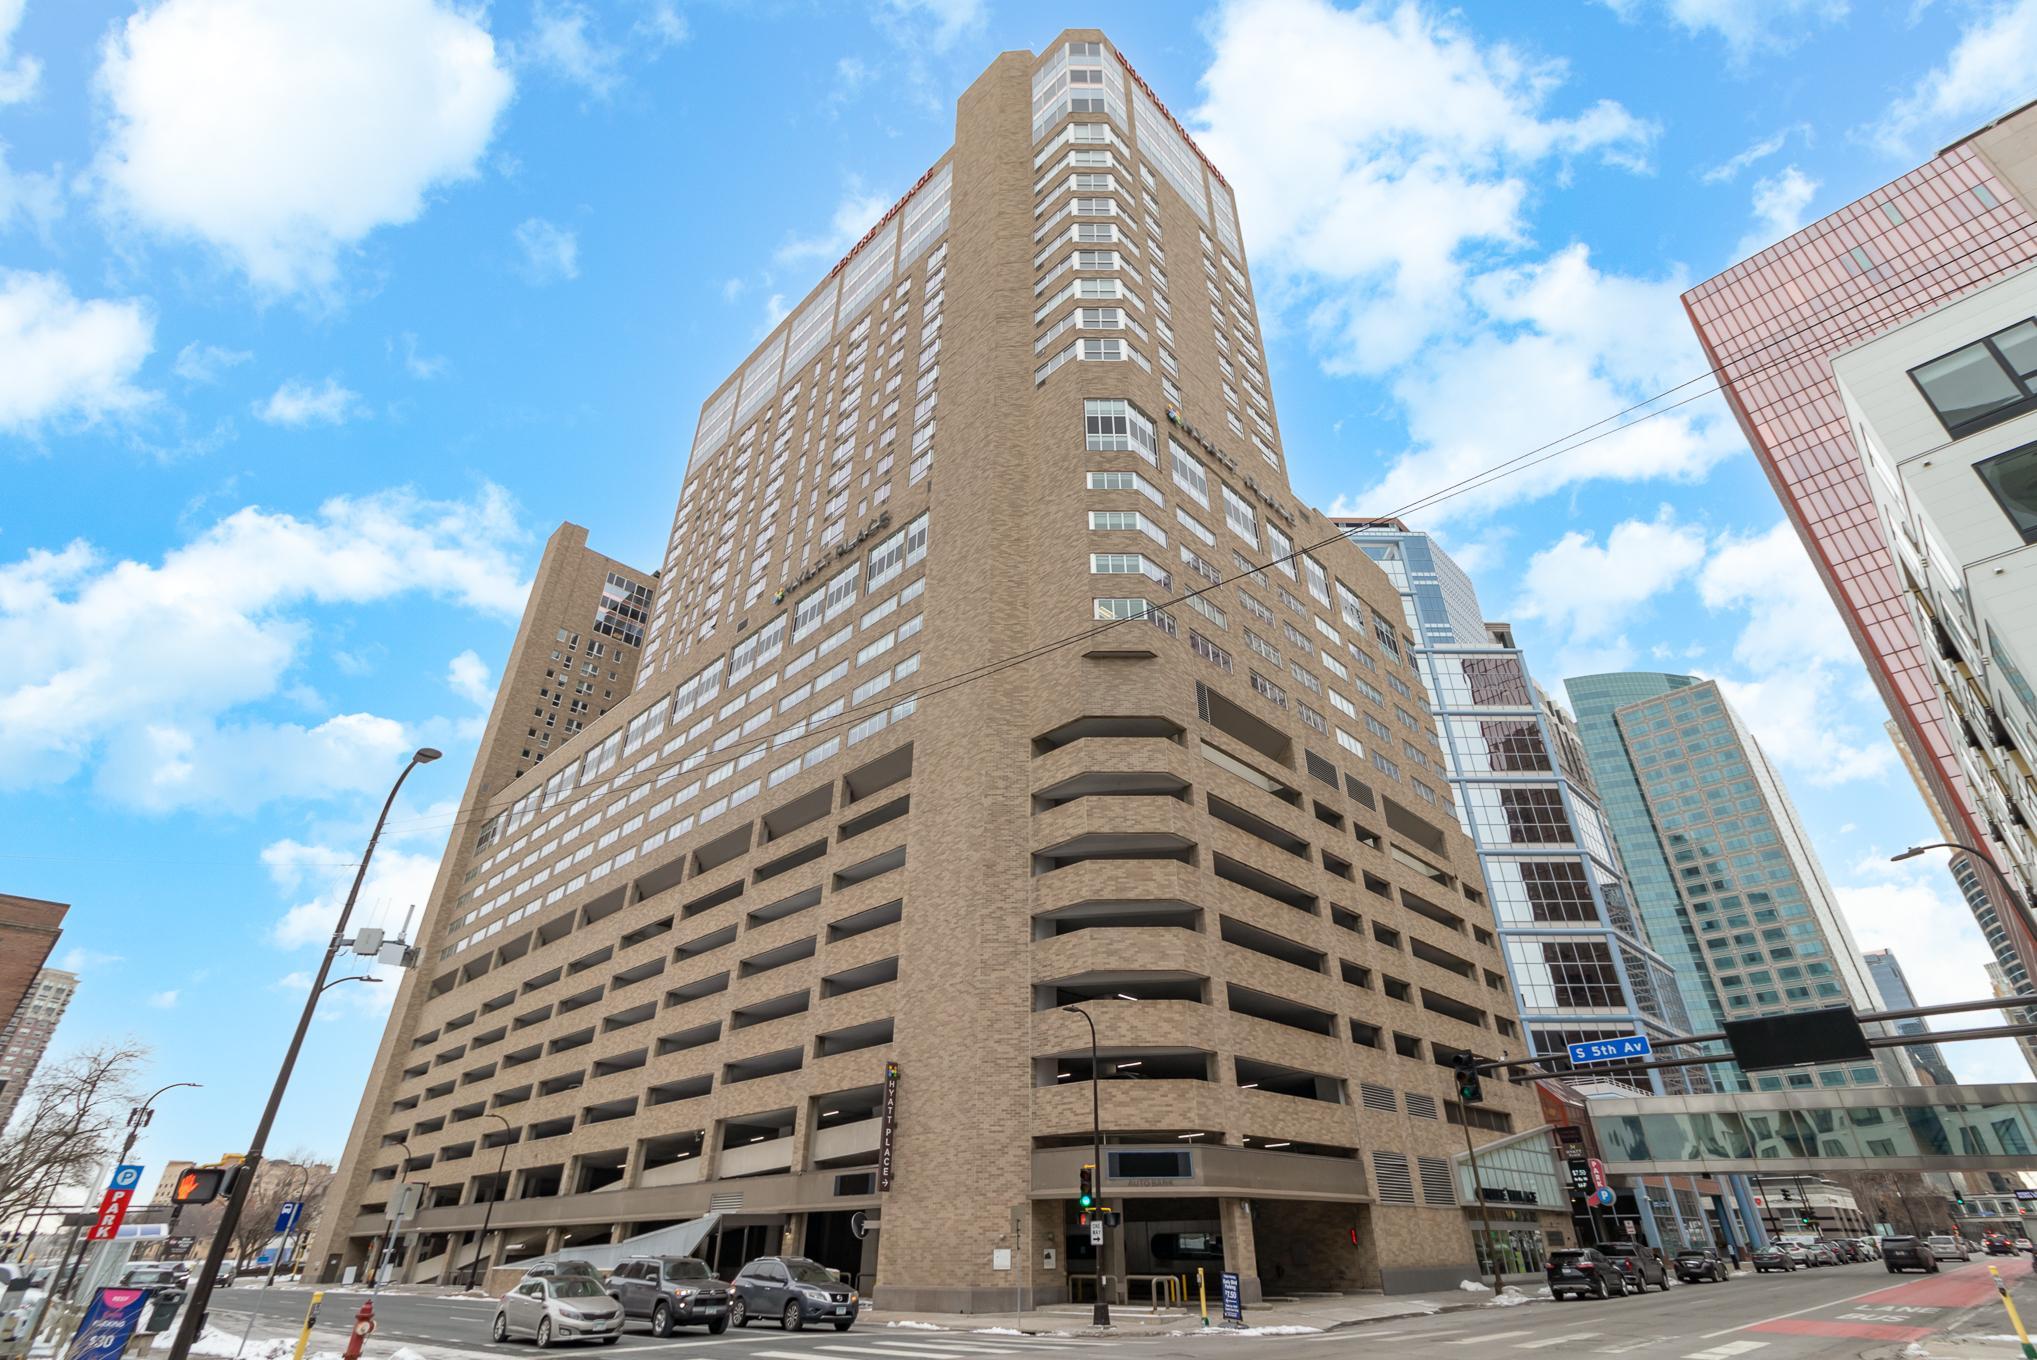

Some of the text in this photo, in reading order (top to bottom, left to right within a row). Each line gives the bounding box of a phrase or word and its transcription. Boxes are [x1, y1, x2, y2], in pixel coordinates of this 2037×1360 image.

[831, 167, 933, 278] CENTRE VILLAGE
[1575, 1042, 1641, 1058] S 5th Av
[883, 1081, 895, 1176] HYATT PLACE
[1591, 1160, 1603, 1187] PARK
[95, 1191, 125, 1237] PARK
[1833, 1313, 1911, 1322] BUS
[1853, 1304, 1942, 1314] LANE
